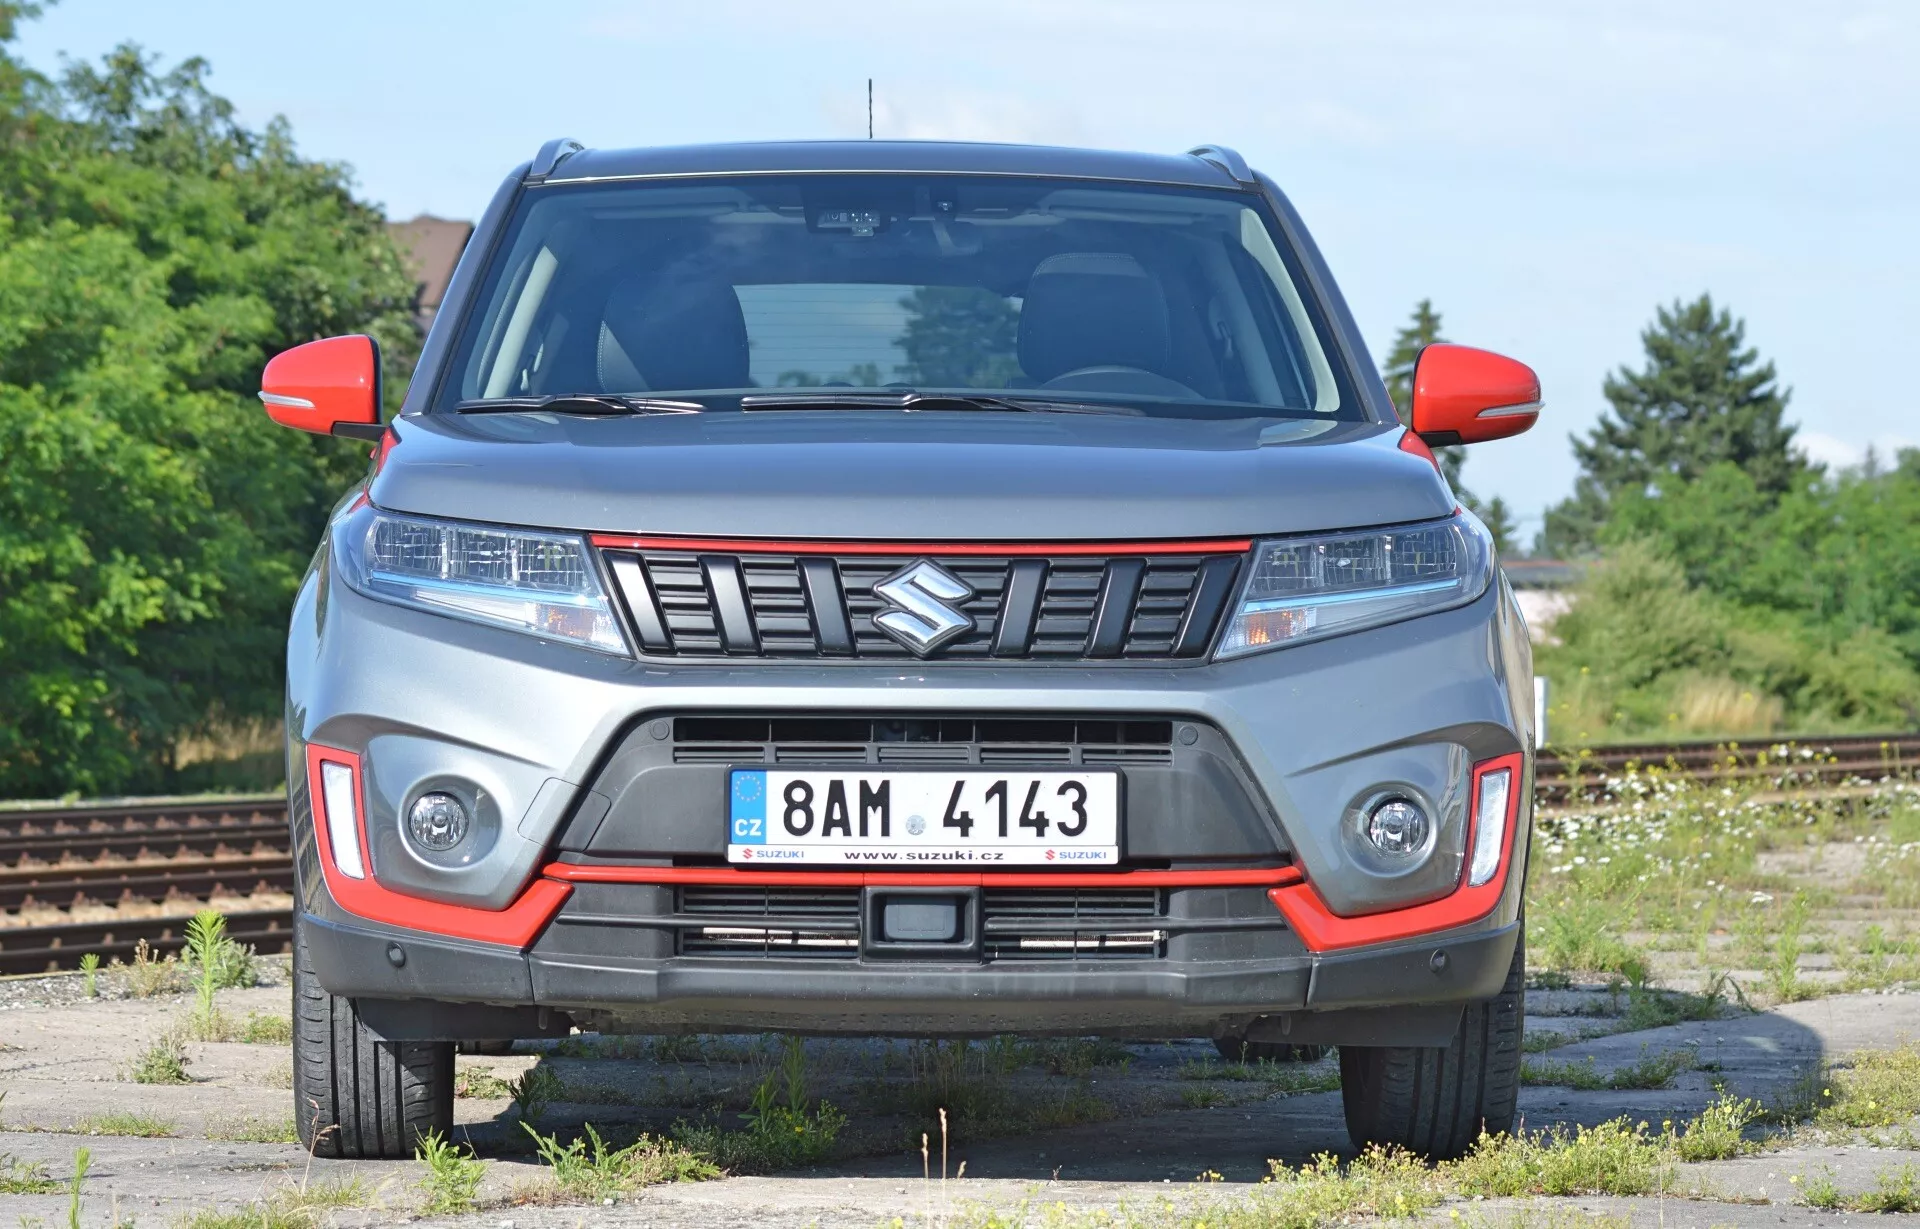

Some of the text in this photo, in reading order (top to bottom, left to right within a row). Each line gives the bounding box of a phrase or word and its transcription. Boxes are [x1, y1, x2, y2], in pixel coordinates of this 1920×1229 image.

[783, 779, 1087, 837] 8AM 4143
[734, 819, 762, 836] CZ
[756, 849, 804, 858] SUZUKI
[844, 850, 1004, 861] www.suzuki.cz
[1059, 851, 1107, 860] SUZUKI
